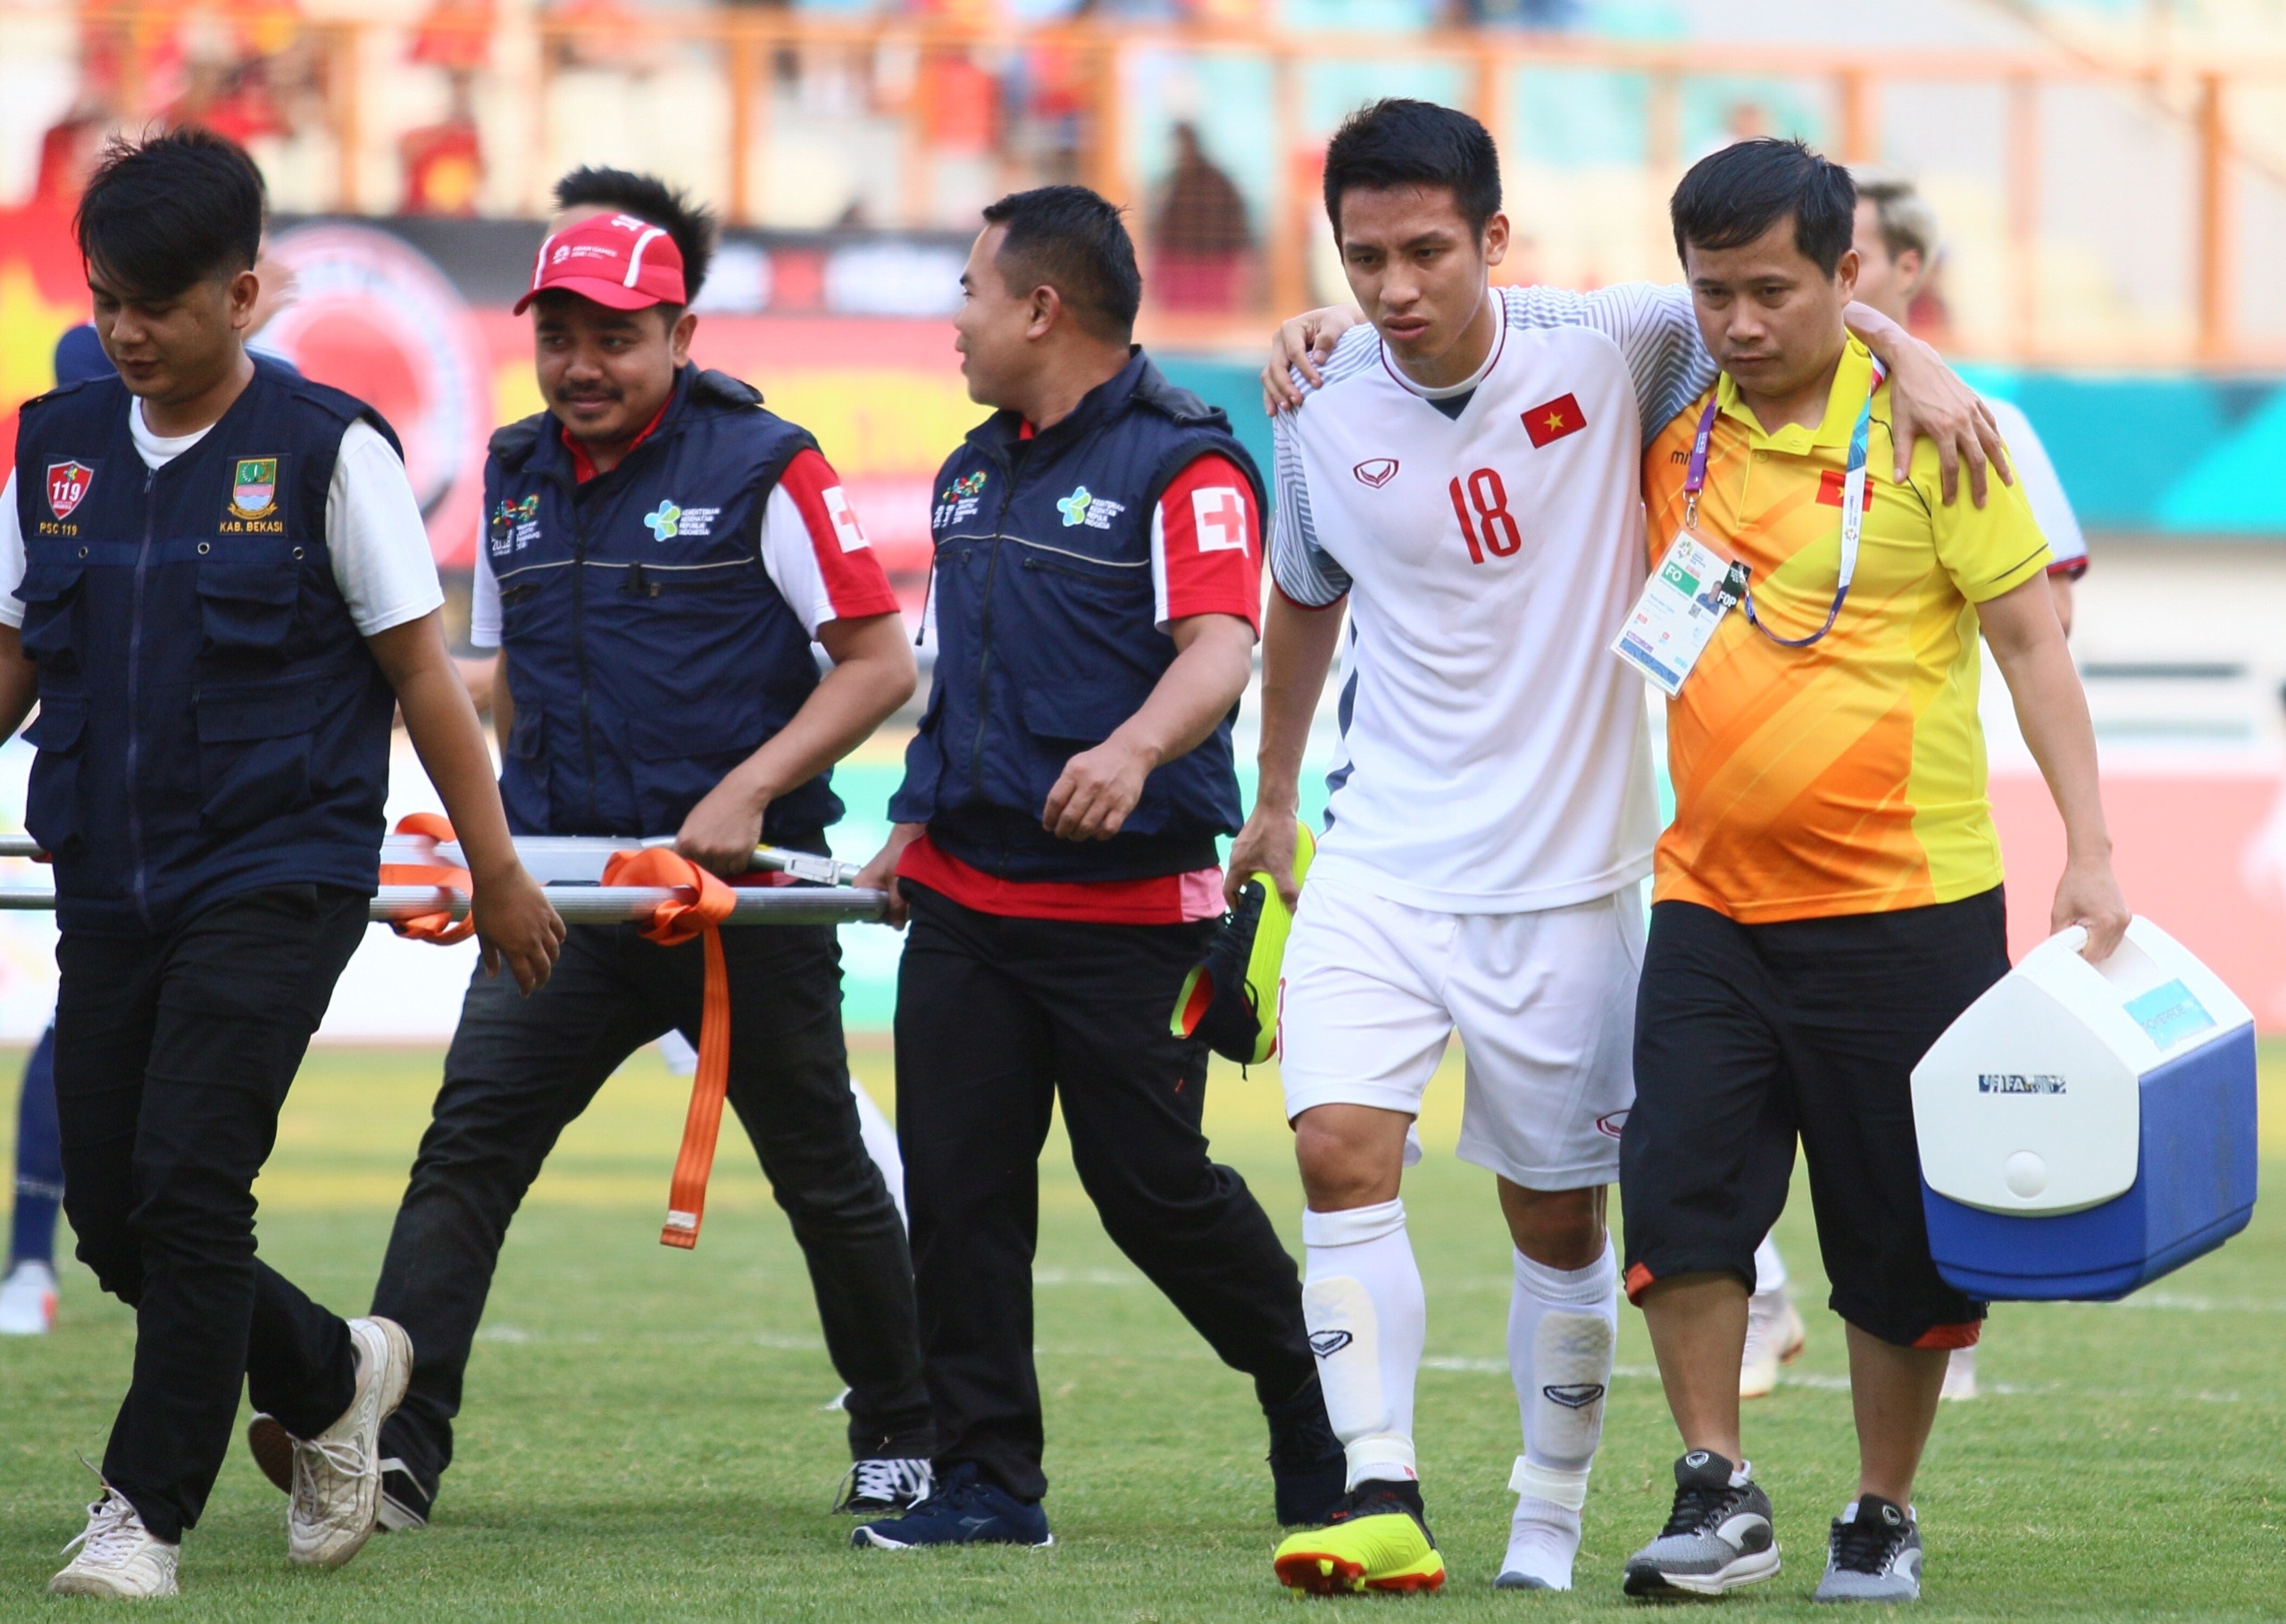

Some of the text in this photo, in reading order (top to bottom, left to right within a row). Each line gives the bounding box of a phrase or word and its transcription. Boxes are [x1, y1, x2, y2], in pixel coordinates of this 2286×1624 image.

[592, 246, 617, 257] GAMES
[53, 480, 81, 502] 119
[1449, 468, 1522, 564] 18
[39, 522, 78, 536] PSC 119
[220, 521, 283, 532] KAB. BEKASI
[1665, 565, 1682, 582] FO
[1716, 590, 1737, 607] FOP
